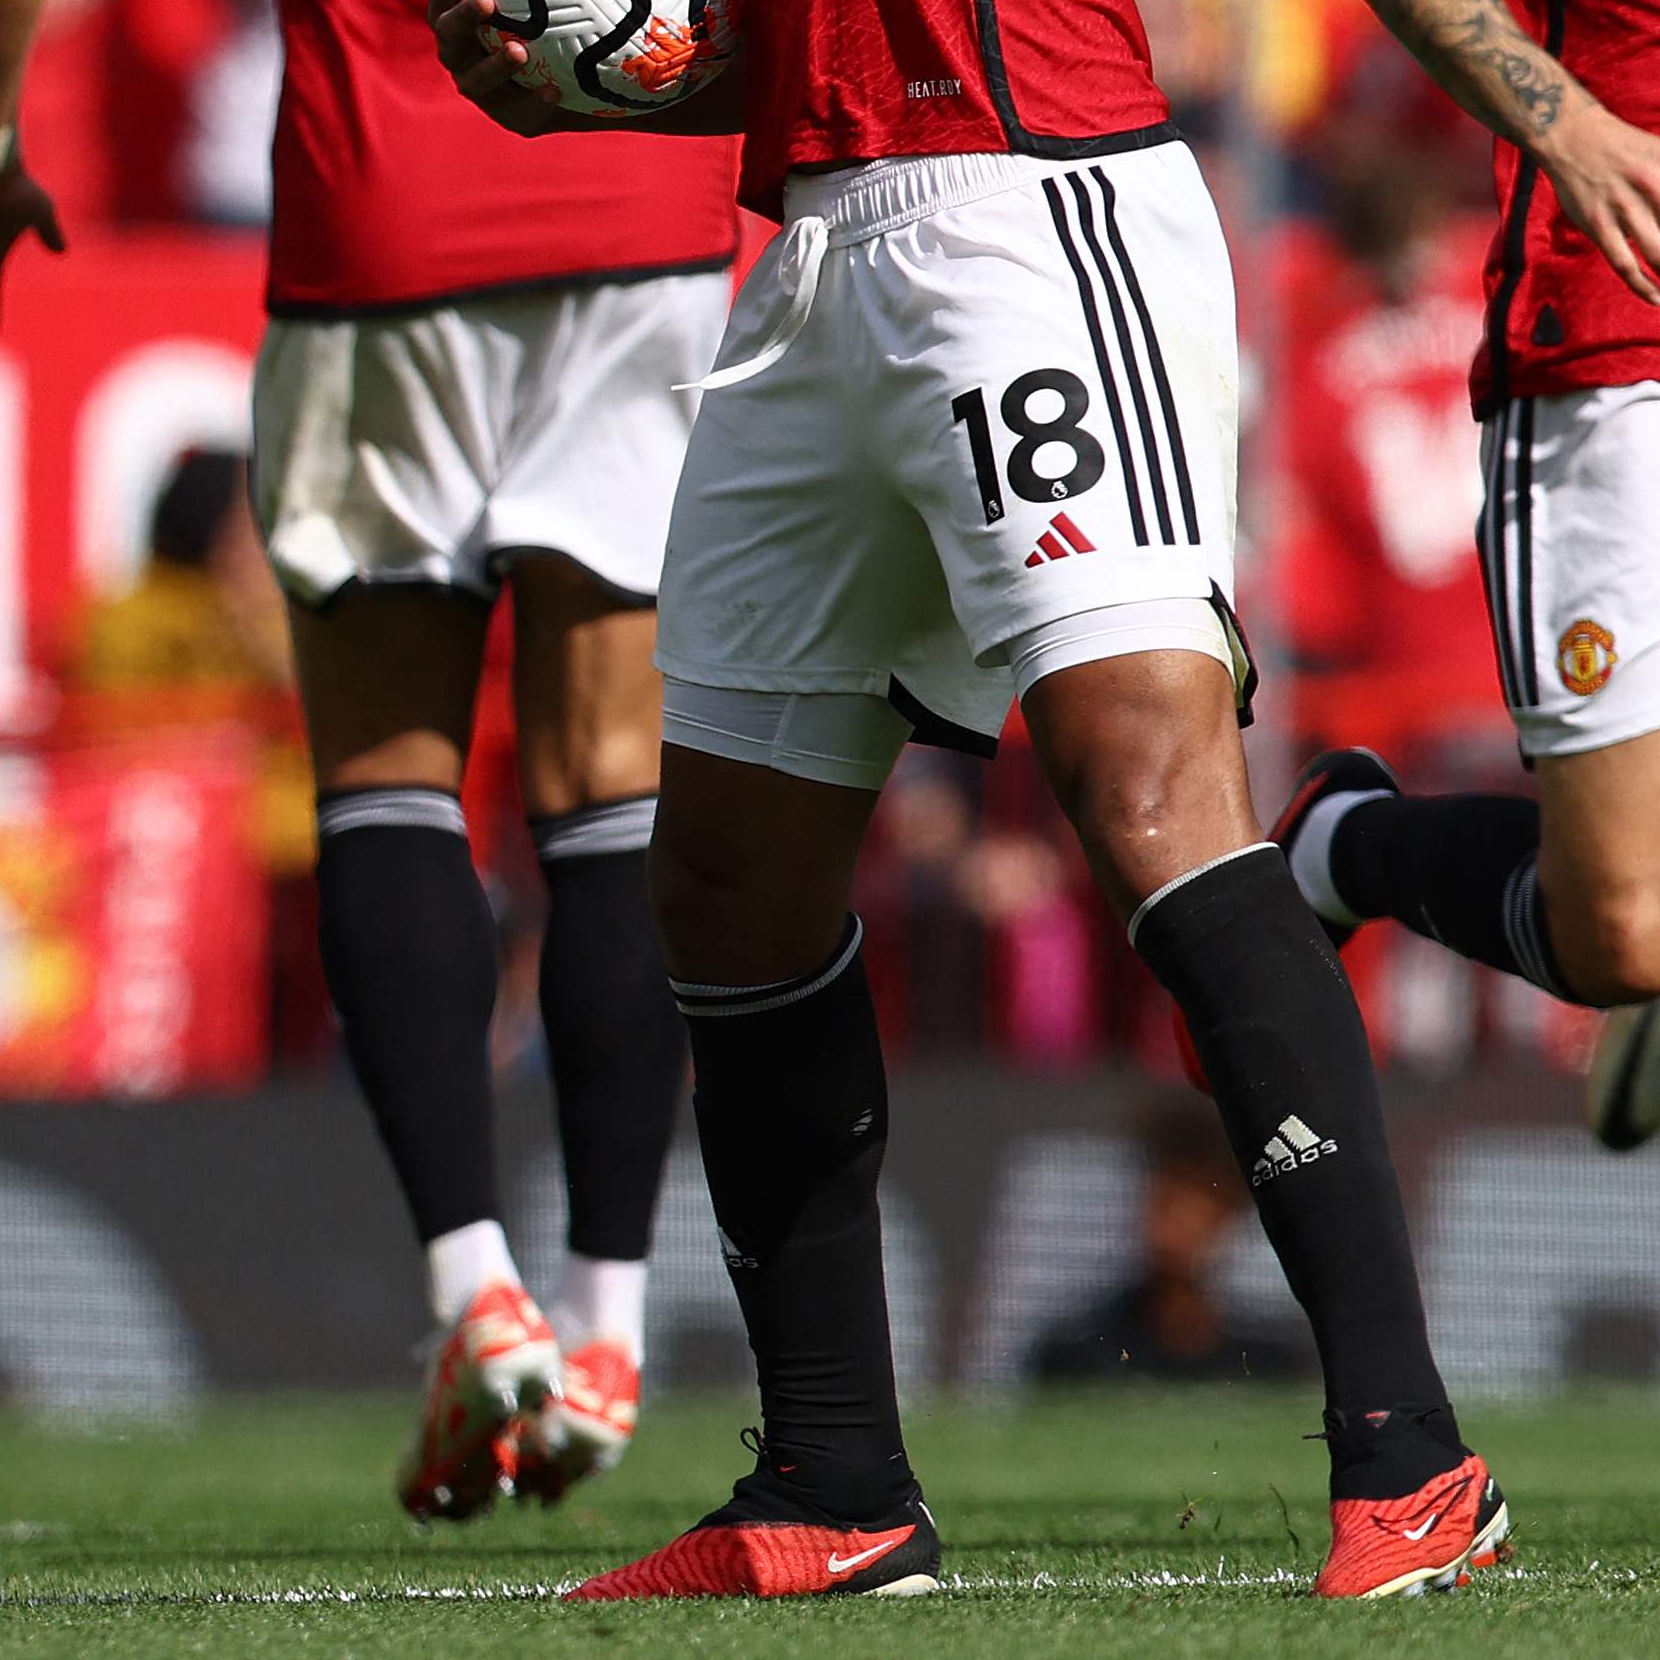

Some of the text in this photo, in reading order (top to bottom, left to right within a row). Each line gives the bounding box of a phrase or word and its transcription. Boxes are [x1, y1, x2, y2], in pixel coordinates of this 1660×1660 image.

[907, 78, 962, 99] HEAT.RDY
[951, 367, 1106, 526] 18
[1251, 1138, 1339, 1187] adidas
